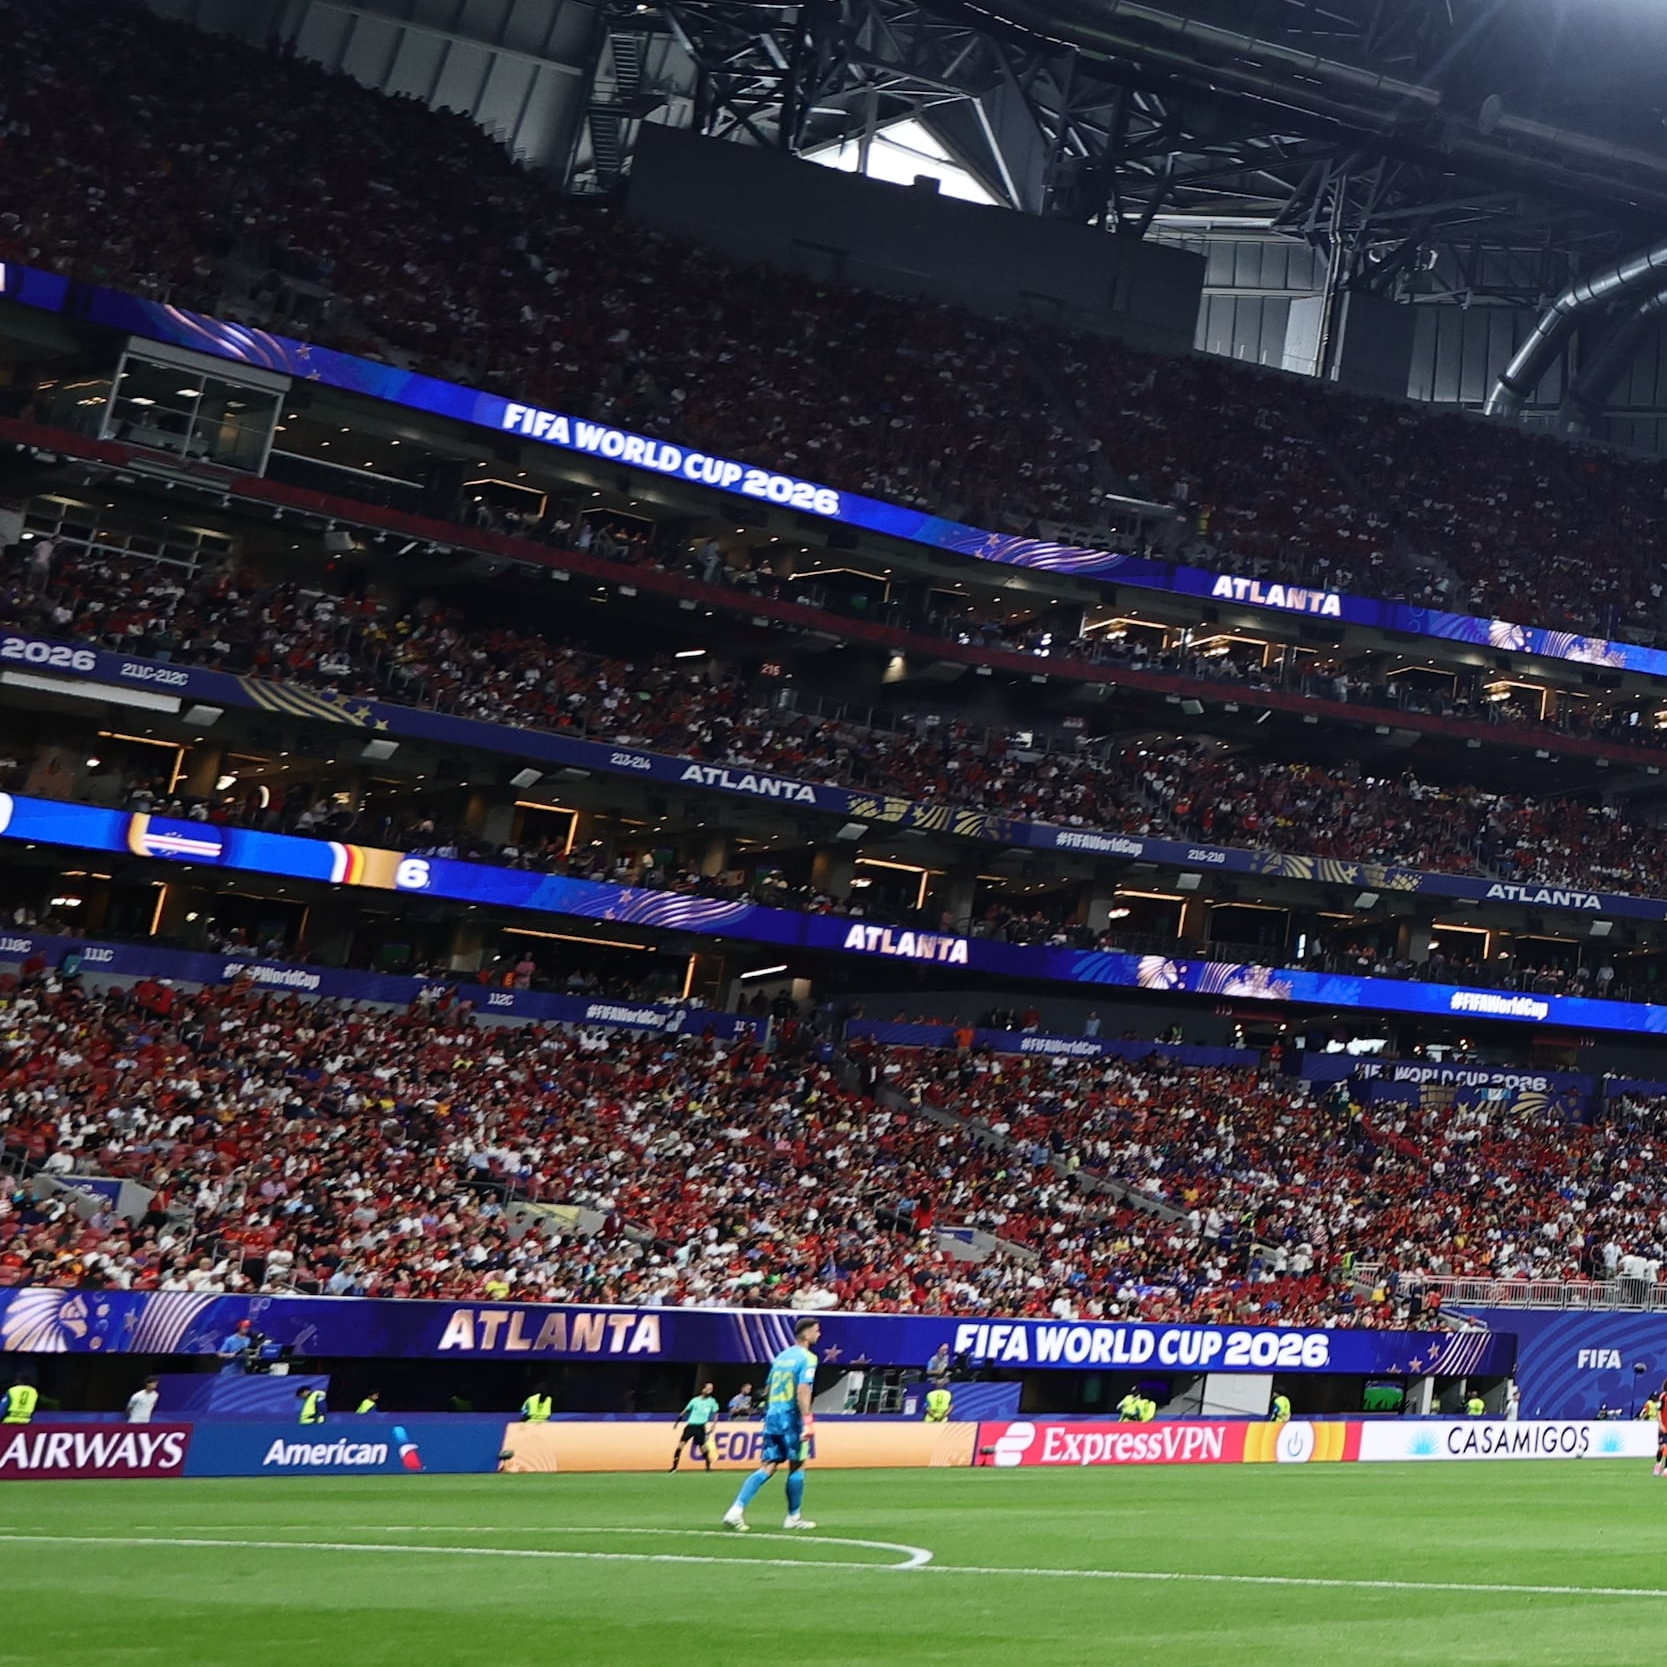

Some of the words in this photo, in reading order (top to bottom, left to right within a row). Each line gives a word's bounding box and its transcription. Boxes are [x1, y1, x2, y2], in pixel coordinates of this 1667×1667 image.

[503, 402, 571, 445] FIFA
[576, 420, 682, 472] WORLD
[683, 452, 743, 488] CUP
[742, 470, 841, 516] 2026
[1211, 574, 1341, 617] ATLANTA
[1, 637, 97, 672] 2026
[680, 764, 816, 804] ATLANTA
[1056, 831, 1144, 858] #FIFAWorldCup
[396, 859, 430, 889] 6
[1486, 883, 1602, 910] ATLANTA
[844, 924, 969, 965] ATLANTA
[1450, 992, 1549, 1020] #FIFAWorldCup
[438, 1309, 661, 1354] ATLANTA
[954, 1323, 1028, 1362] FIFA
[1036, 1326, 1155, 1365] WORLD
[1158, 1328, 1222, 1365] CUP
[1223, 1331, 1329, 1367] 2026
[1577, 1348, 1622, 1370] FIFA
[0, 1431, 186, 1470] AIRWAYS
[263, 1438, 388, 1468] American
[1041, 1425, 1226, 1465] ExpressVPN
[1447, 1424, 1590, 1456] CASAMIGOS
